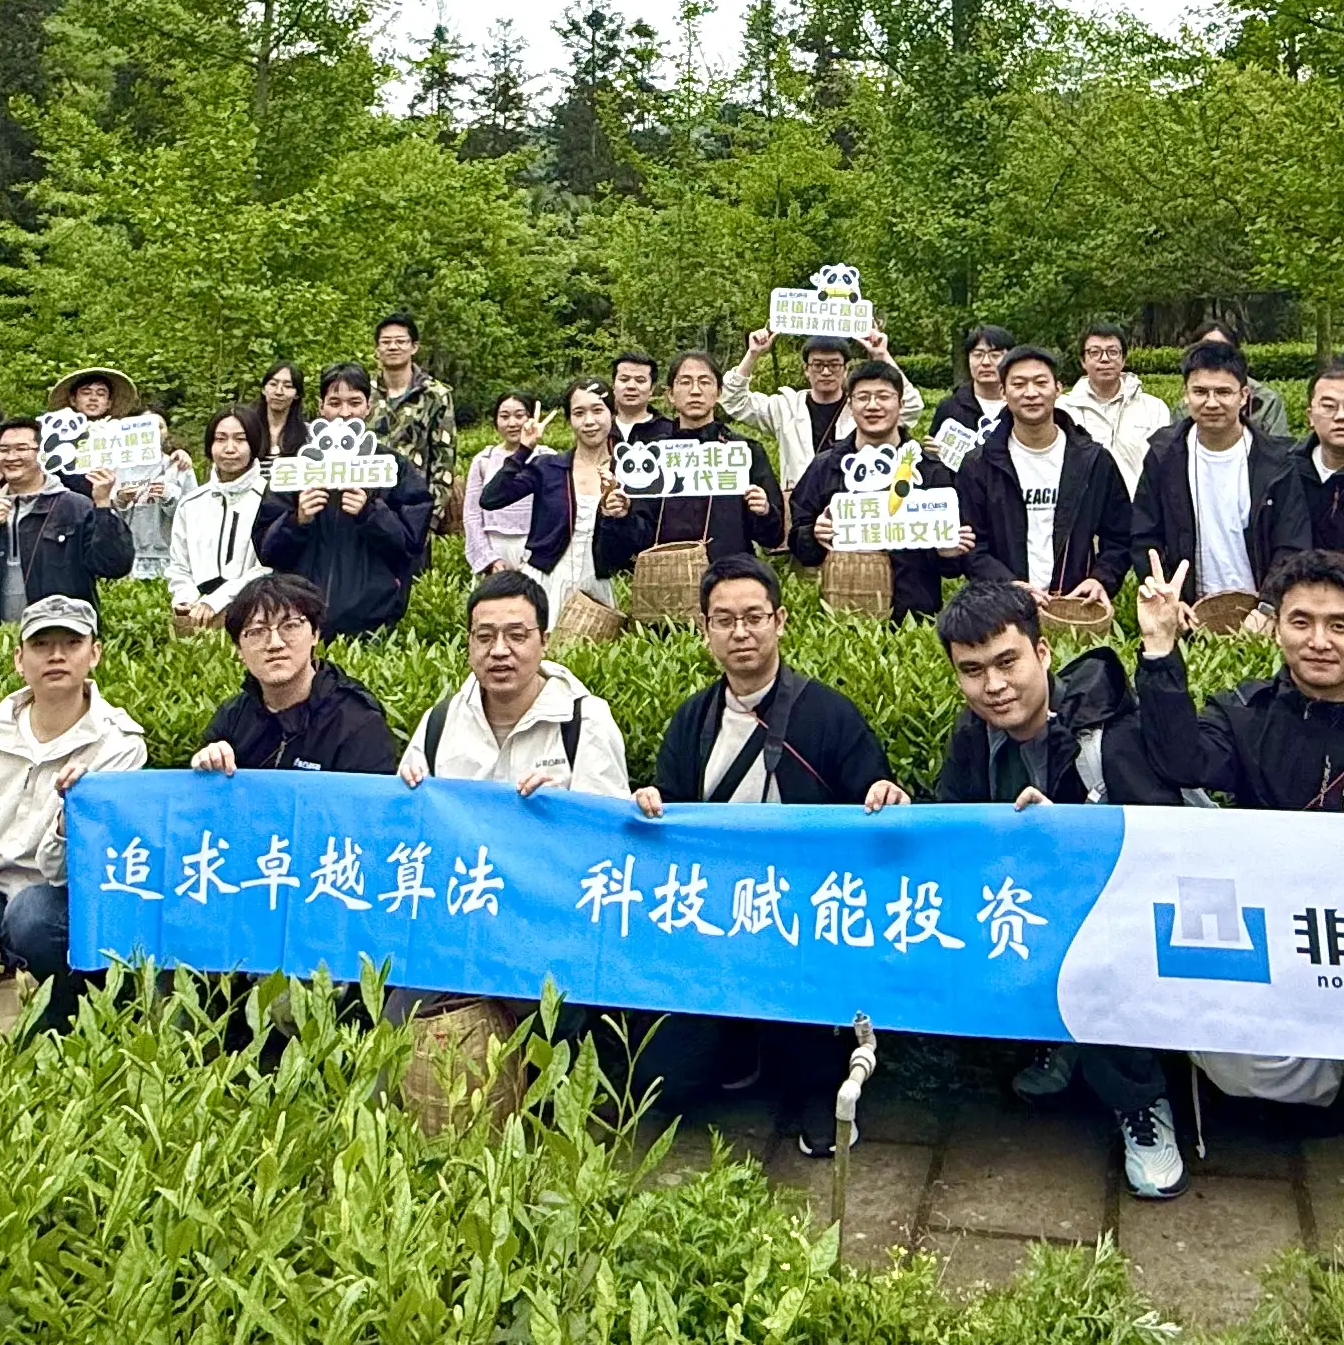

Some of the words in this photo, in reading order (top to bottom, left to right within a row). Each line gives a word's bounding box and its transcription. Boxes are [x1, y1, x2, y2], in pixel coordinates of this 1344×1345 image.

[665, 447, 747, 468] 我为非凸
[273, 461, 393, 486] 全员Rust
[693, 470, 738, 491] 代言
[1024, 488, 1057, 505] EAG
[837, 497, 879, 519] 优秀
[838, 520, 954, 544] 工程师文化
[99, 830, 505, 919] 追求卓越算法
[575, 854, 1049, 960] 科技赋能投资
